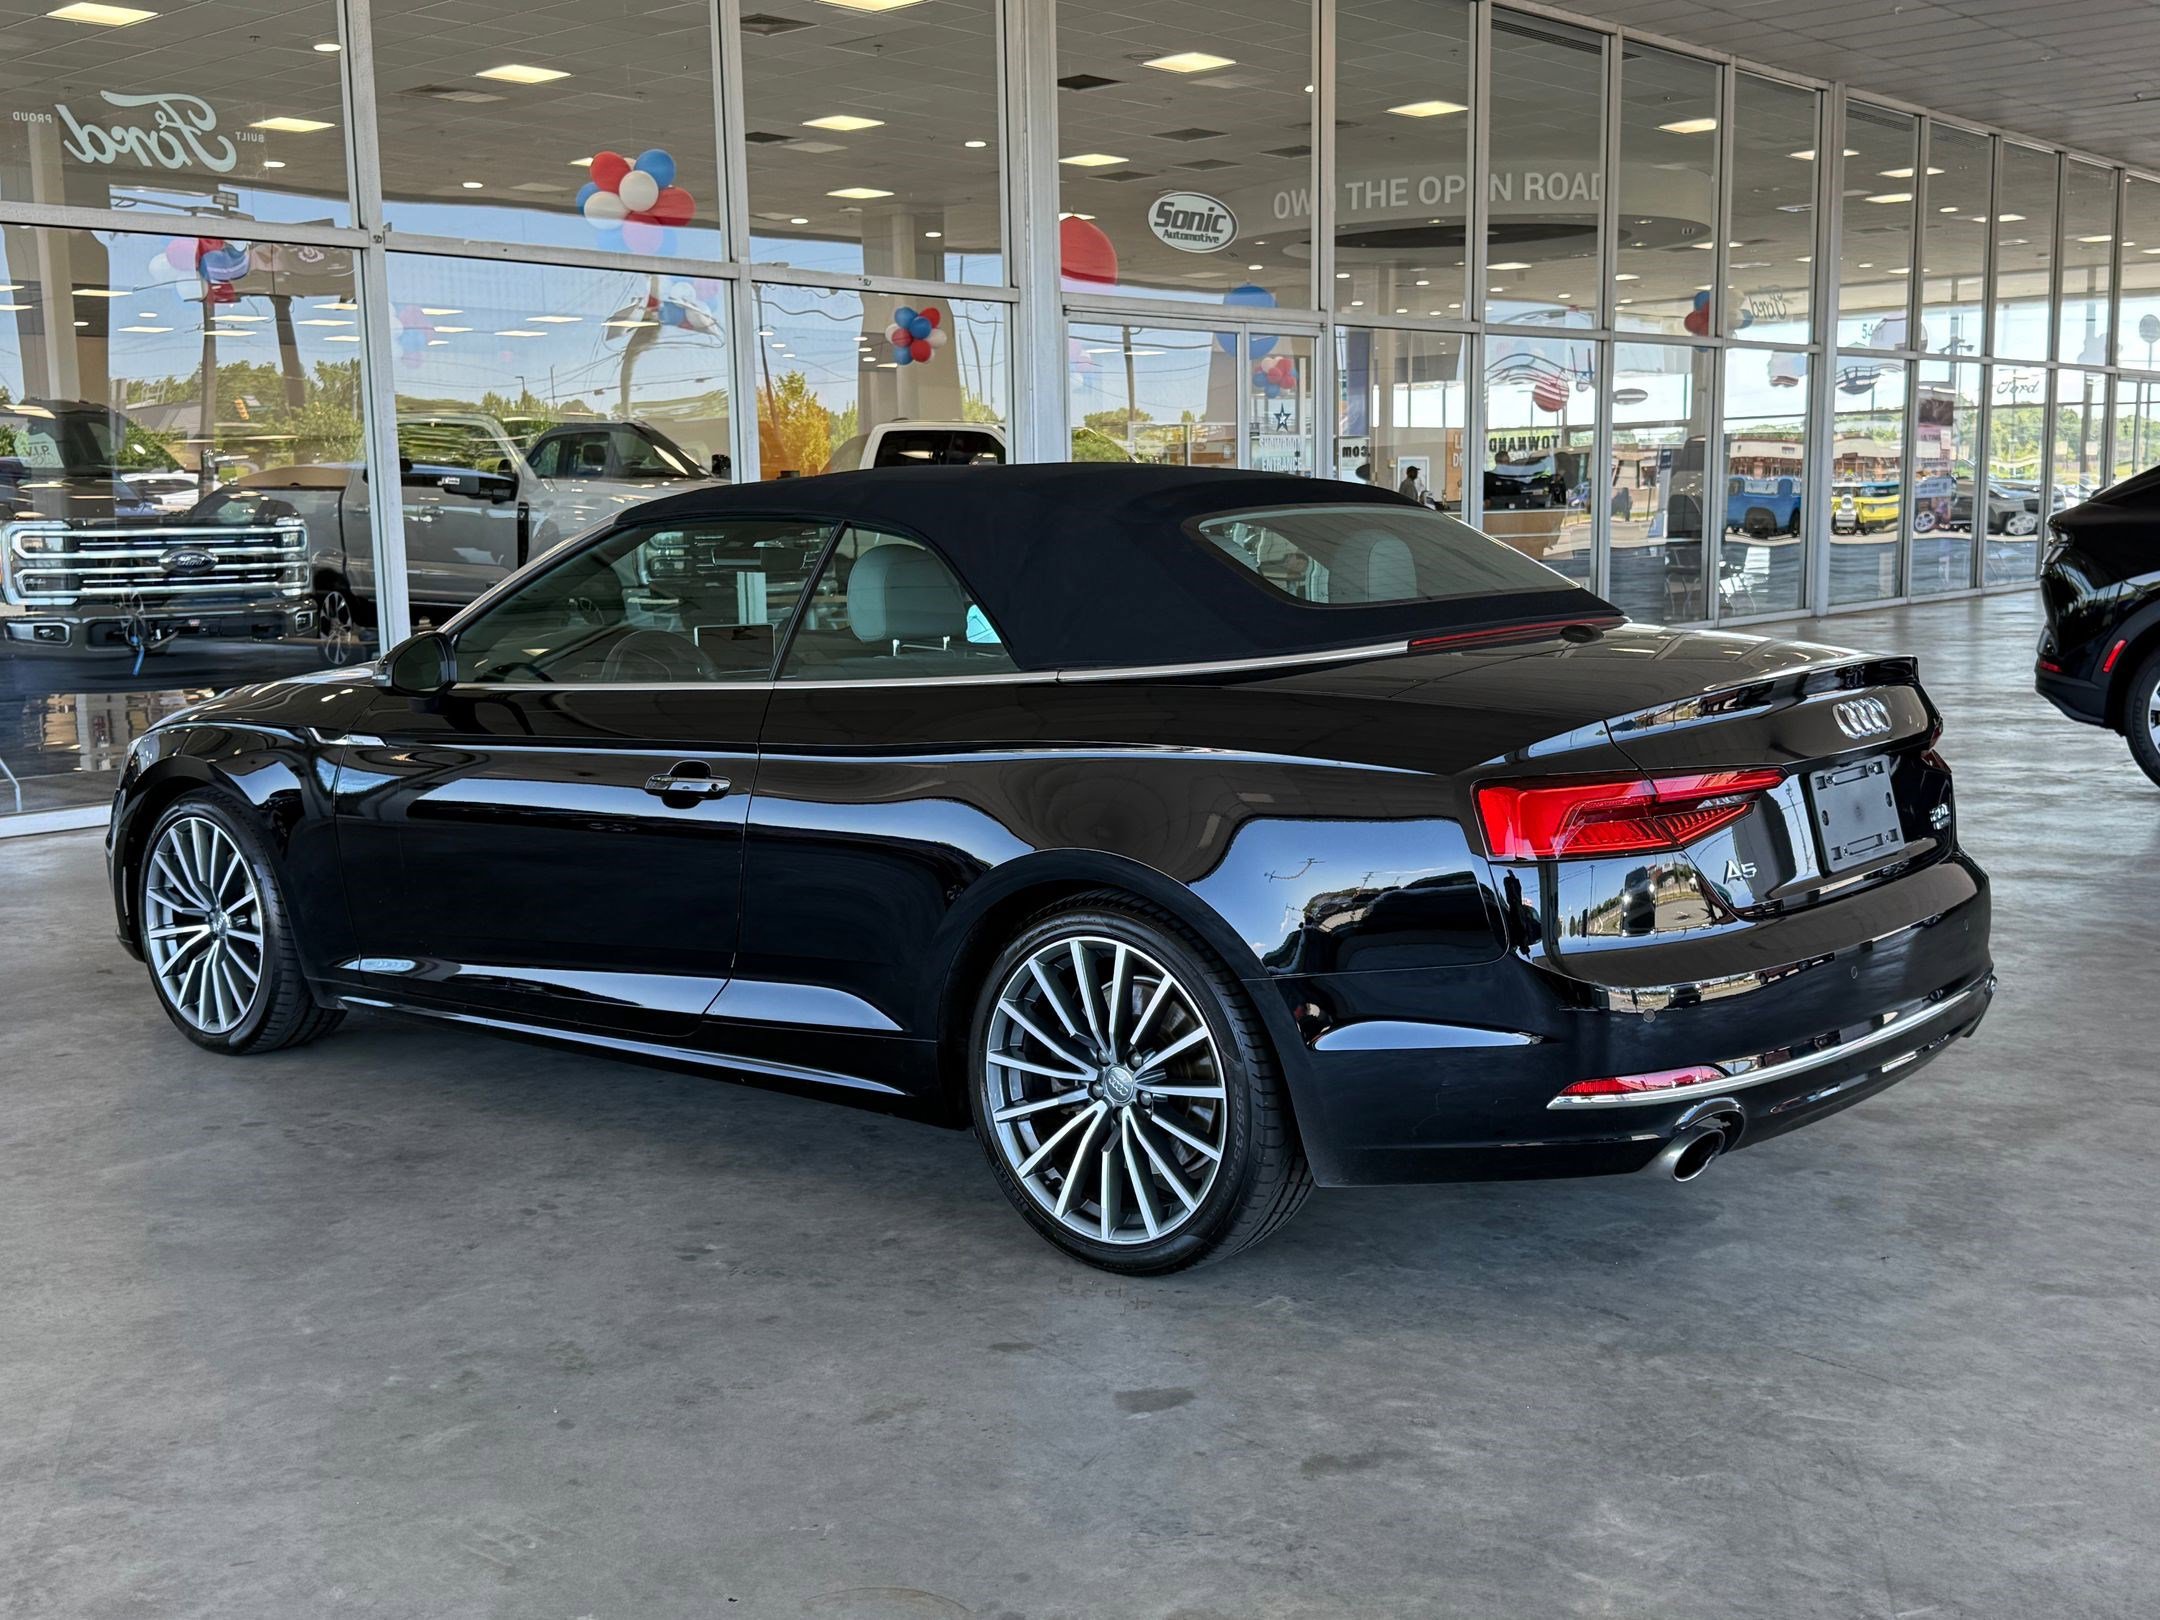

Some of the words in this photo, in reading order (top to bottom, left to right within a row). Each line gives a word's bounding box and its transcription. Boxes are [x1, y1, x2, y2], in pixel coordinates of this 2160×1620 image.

[1273, 187, 1322, 220] OW
[1345, 177, 1409, 210] THE
[1418, 173, 1512, 205] OPN
[1153, 200, 1227, 234] Sonic
[1162, 229, 1220, 244] Automotive
[1996, 377, 2040, 394] Ford
[1723, 859, 1758, 885] A5
